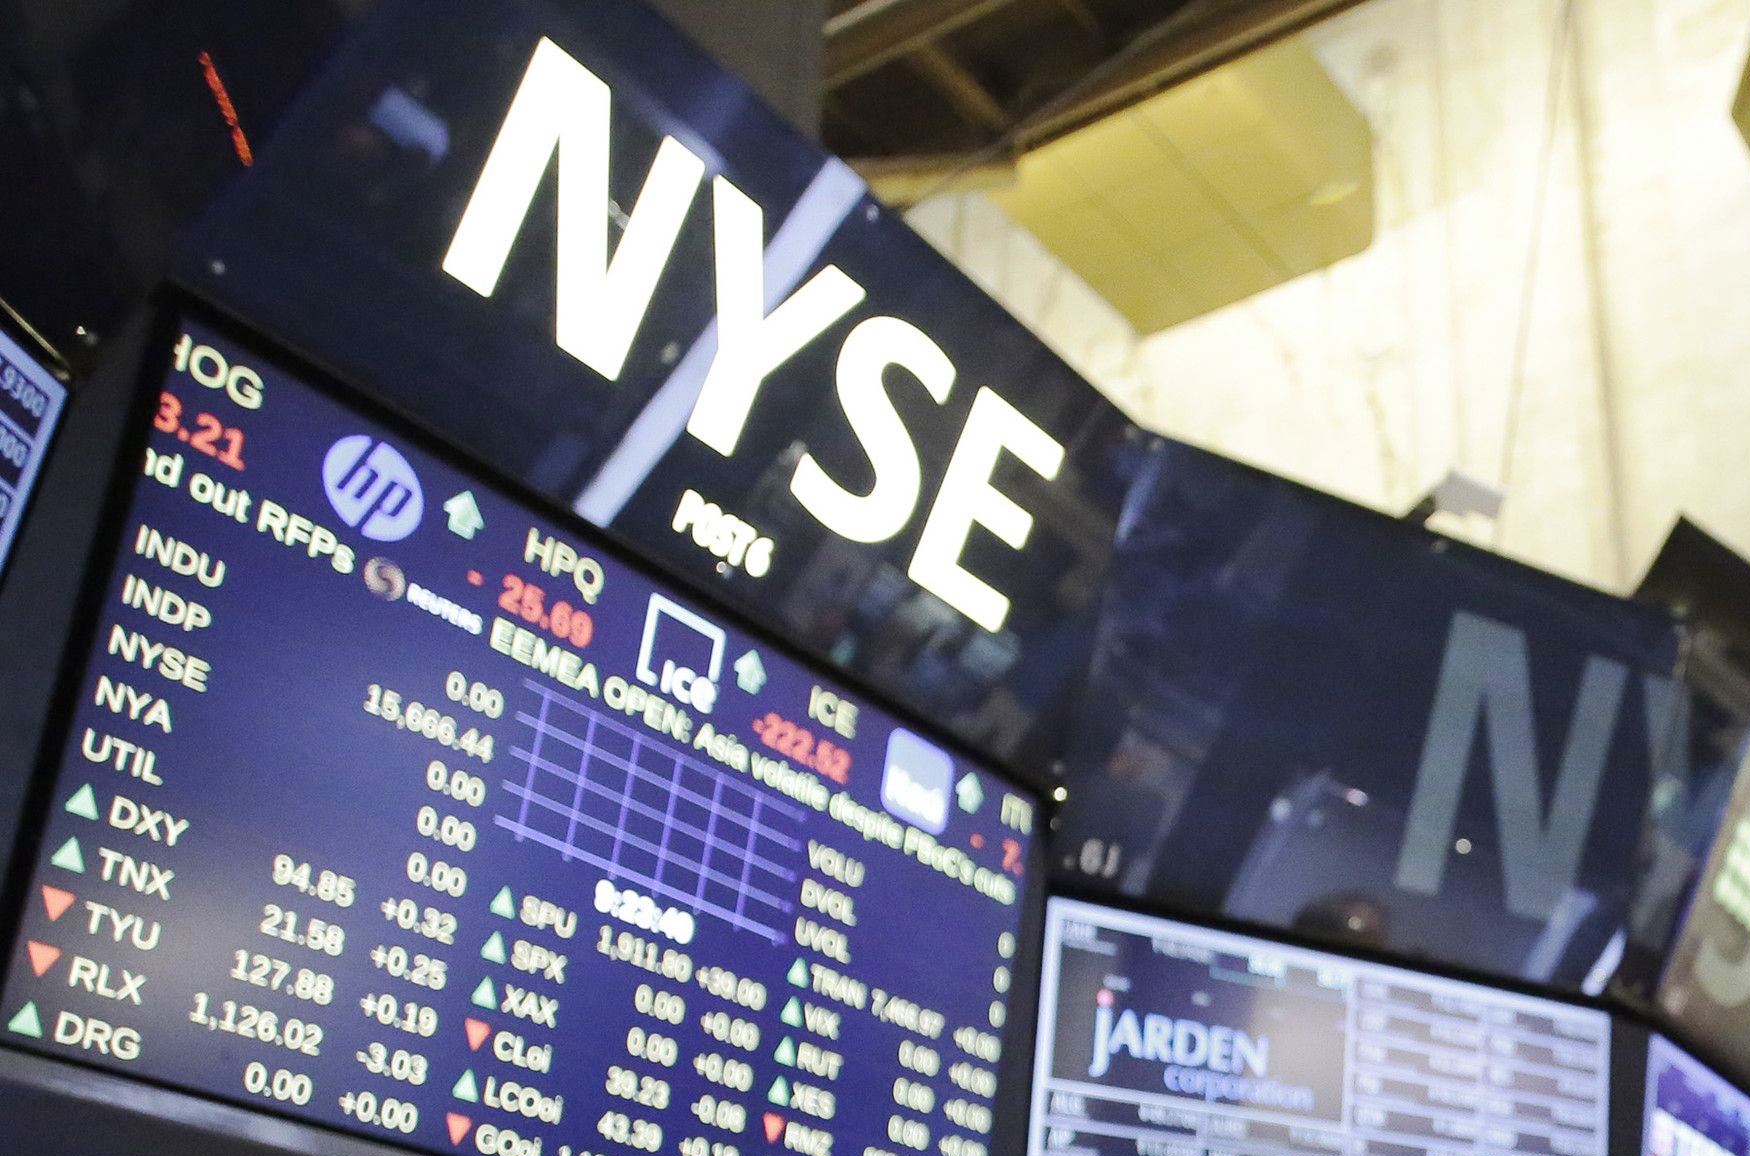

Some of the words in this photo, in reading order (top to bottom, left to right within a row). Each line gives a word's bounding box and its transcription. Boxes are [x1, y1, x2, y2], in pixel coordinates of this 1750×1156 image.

[442, 35, 1066, 634] NYSE
[153, 391, 247, 472] 3.21
[189, 472, 252, 524] out
[256, 499, 356, 575] RFPs
[672, 489, 757, 567] POST
[745, 537, 774, 578] 6
[122, 574, 213, 633] INDP
[524, 527, 605, 605] HPQ
[135, 524, 226, 588] INDU
[445, 671, 505, 719] 0.00
[489, 616, 600, 699] EEMEA
[108, 624, 213, 693] NYSE
[426, 760, 487, 807] 0.00
[808, 685, 860, 740] ICE
[95, 676, 173, 733] NYA
[416, 805, 477, 852] 0.00
[82, 728, 163, 786] UTIL
[406, 851, 468, 898] 0.00
[108, 795, 190, 846] DXY
[98, 847, 175, 899] TNX
[84, 900, 162, 951] TYU
[520, 895, 577, 938] SPU
[68, 956, 148, 1005] RLX
[511, 939, 568, 984] SPX
[634, 984, 686, 1025] 0.00
[804, 1001, 841, 1041] VIX
[501, 983, 559, 1029] XAX
[627, 1027, 678, 1067] 0.00
[54, 1010, 142, 1061] DRG
[244, 1062, 313, 1106] 0.00
[338, 1090, 419, 1134] +0.00
